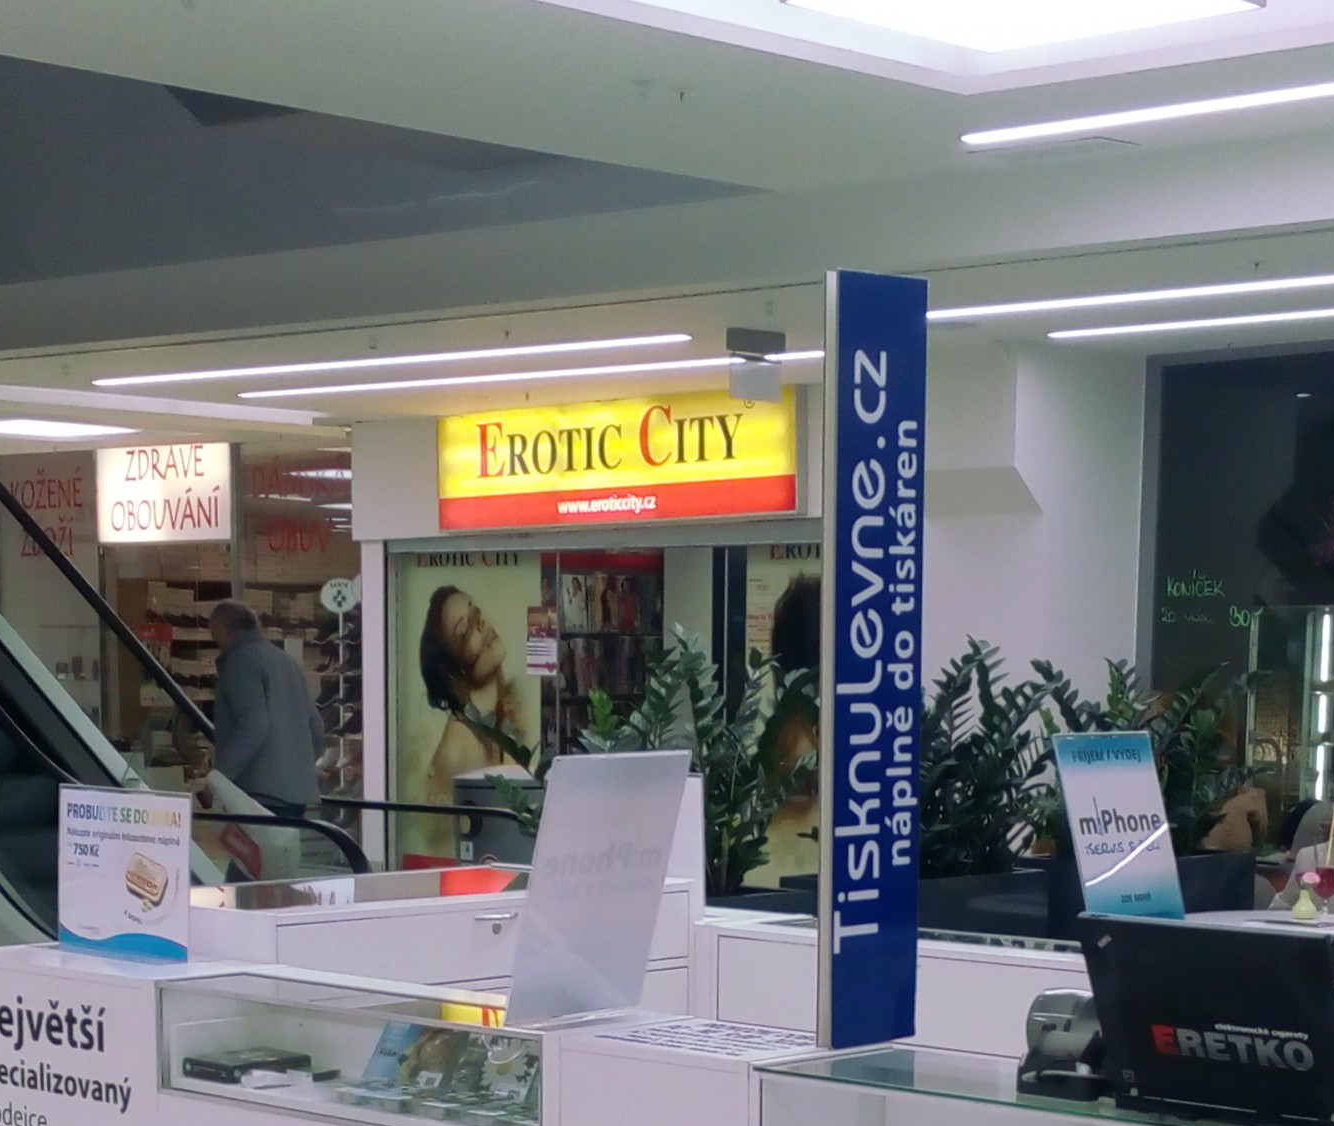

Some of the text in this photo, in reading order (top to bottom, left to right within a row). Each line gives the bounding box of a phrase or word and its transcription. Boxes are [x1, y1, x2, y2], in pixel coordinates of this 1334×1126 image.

[477, 404, 744, 478] EROTIC CITY
[110, 485, 220, 532] OBOUVÁNÍ
[557, 493, 657, 516] www.eroticcity.cz
[885, 420, 918, 867] náplně do tiskáren
[119, 807, 131, 824] SE
[133, 808, 149, 825] DO
[73, 842, 100, 858] 750 Kč
[1151, 1024, 1315, 1071] ERETKO
